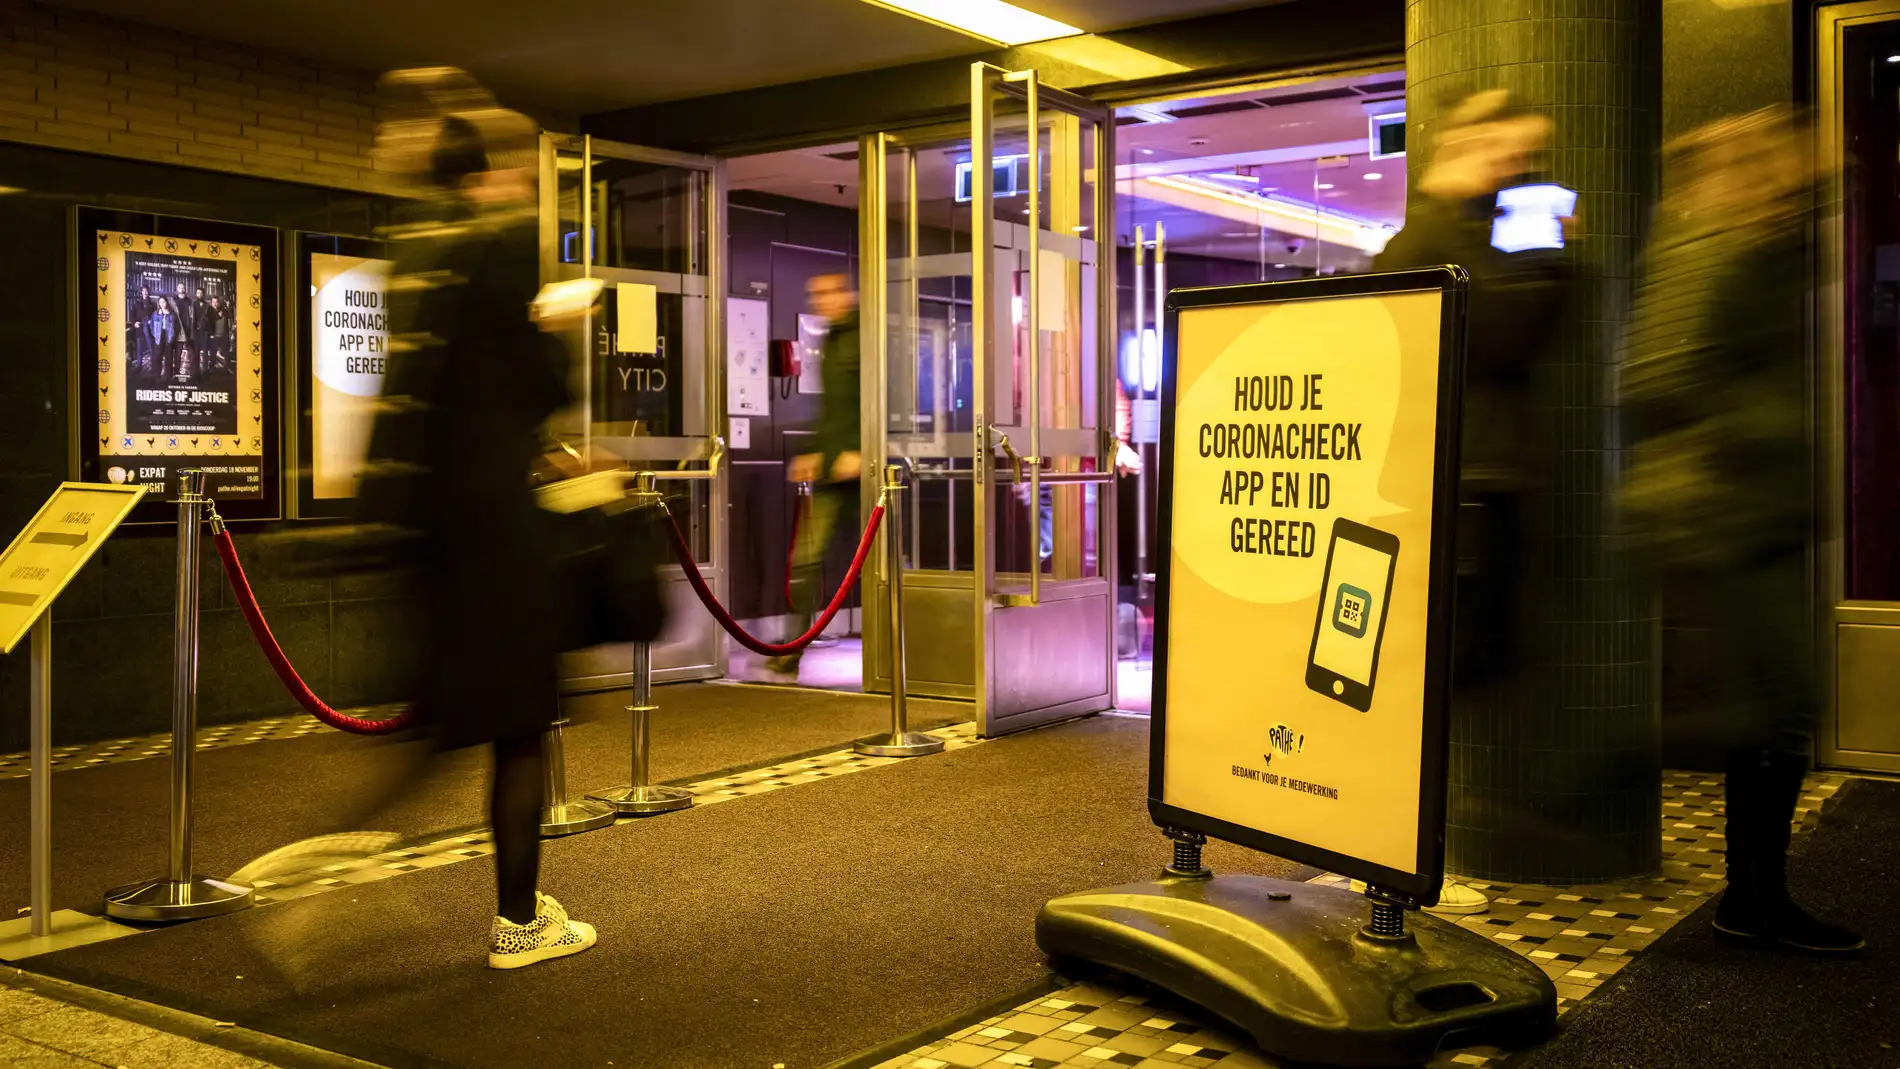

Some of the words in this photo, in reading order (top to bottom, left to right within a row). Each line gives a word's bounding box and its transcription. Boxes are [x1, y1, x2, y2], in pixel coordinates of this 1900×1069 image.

[345, 289, 378, 308] HOUD
[381, 292, 388, 309] J
[325, 310, 390, 331] CORONACH
[339, 334, 364, 351] APP
[368, 336, 383, 352] EN
[346, 356, 388, 375] GEREE
[135, 389, 173, 402] RIDERS
[174, 390, 188, 402] OF
[188, 391, 229, 403] JUSTICE
[1234, 375, 1294, 411] HOUD
[1300, 374, 1323, 411] JE
[1199, 423, 1362, 460] CORONACHECK
[140, 467, 166, 478] EXPAT
[1220, 470, 1264, 506] APP
[1271, 471, 1300, 508] EN
[1308, 472, 1331, 510] ID
[60, 511, 95, 525] INGANG
[1230, 517, 1316, 558] GEREED
[10, 566, 50, 581] UITGANG
[1231, 765, 1260, 781] BEDANKT
[1261, 771, 1279, 786] VOOR
[1280, 776, 1287, 788] JE
[1288, 778, 1338, 800] MEDEWERKING
